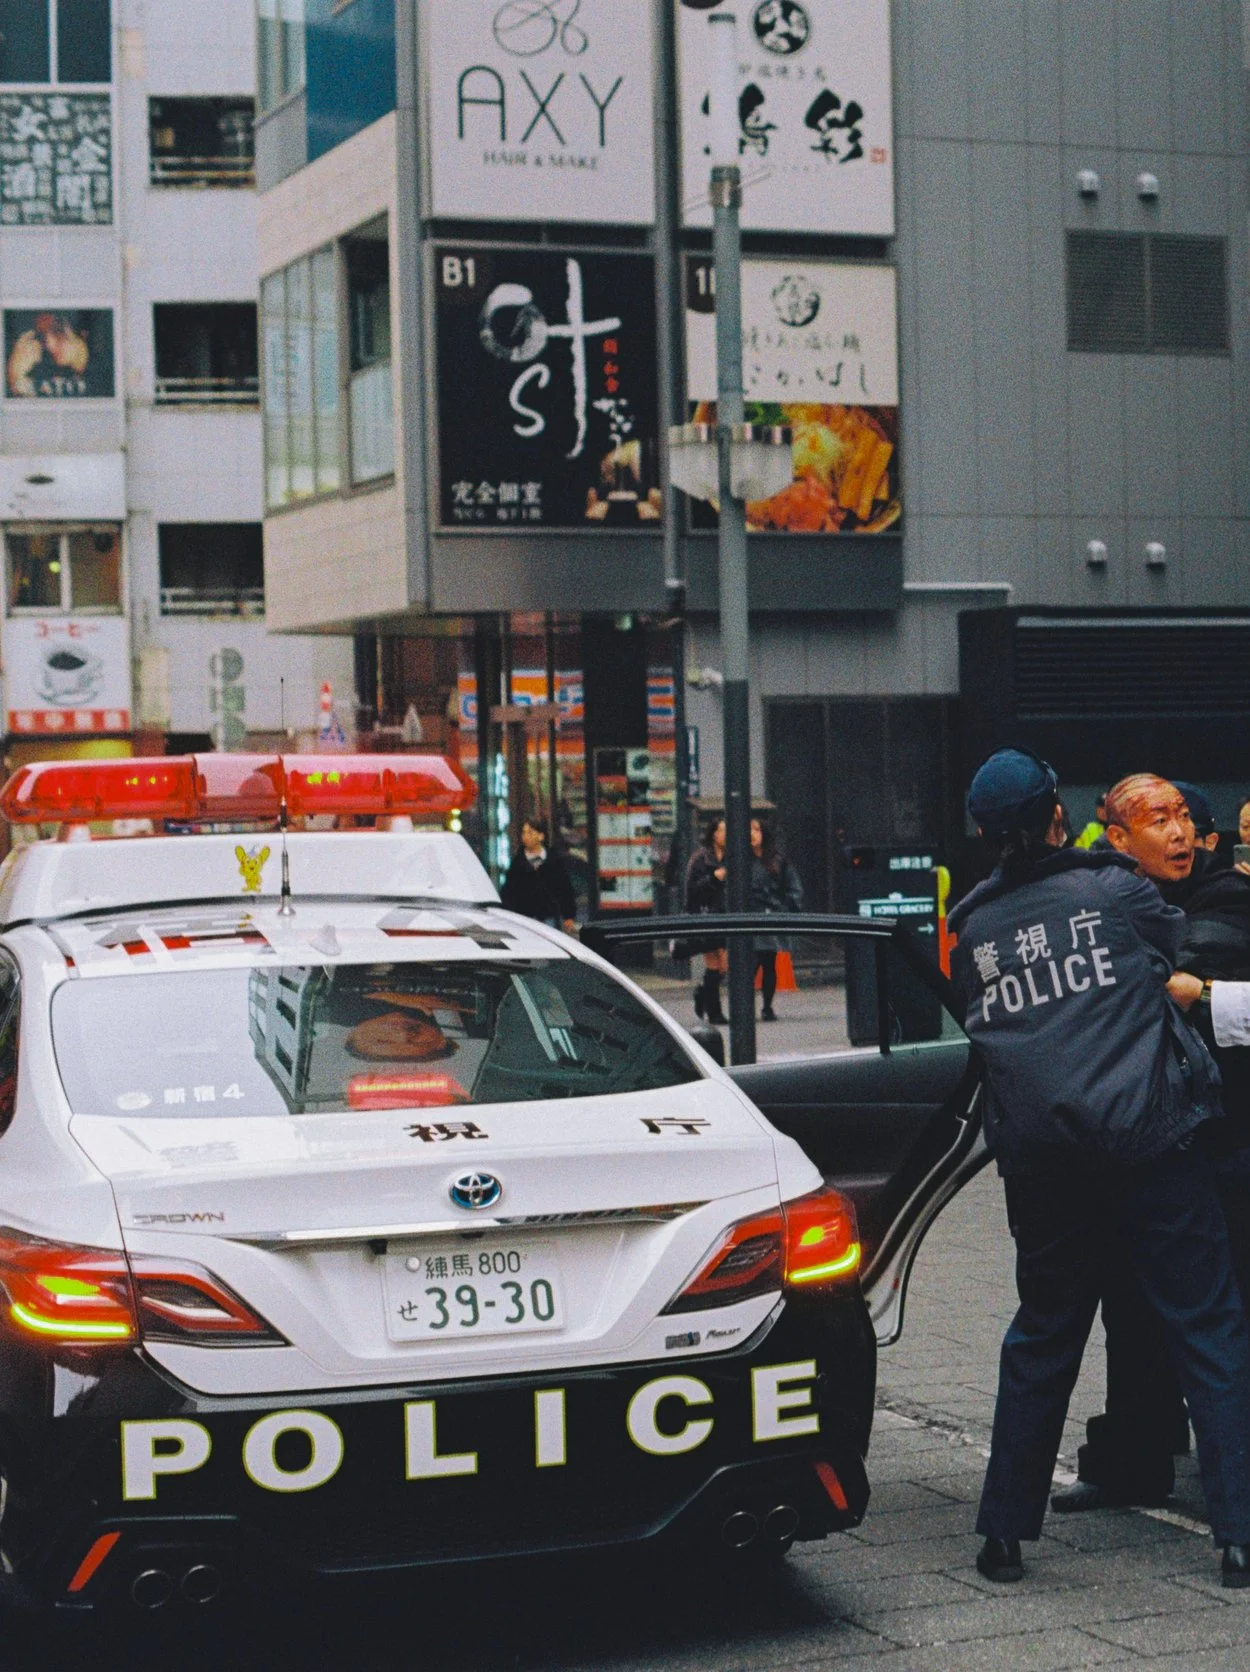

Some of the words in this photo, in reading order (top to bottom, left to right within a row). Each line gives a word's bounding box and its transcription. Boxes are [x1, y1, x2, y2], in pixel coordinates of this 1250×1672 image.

[458, 65, 623, 147] AXY
[442, 256, 476, 287] B1
[973, 909, 1101, 983] 警視庁
[982, 947, 1117, 1022] POLICE
[133, 1211, 225, 1224] CROWN
[425, 1255, 473, 1280] 練馬
[478, 1251, 521, 1276] 800
[398, 1300, 418, 1321] せ
[424, 1278, 555, 1330] 39-30
[120, 1358, 821, 1501] POLICE
